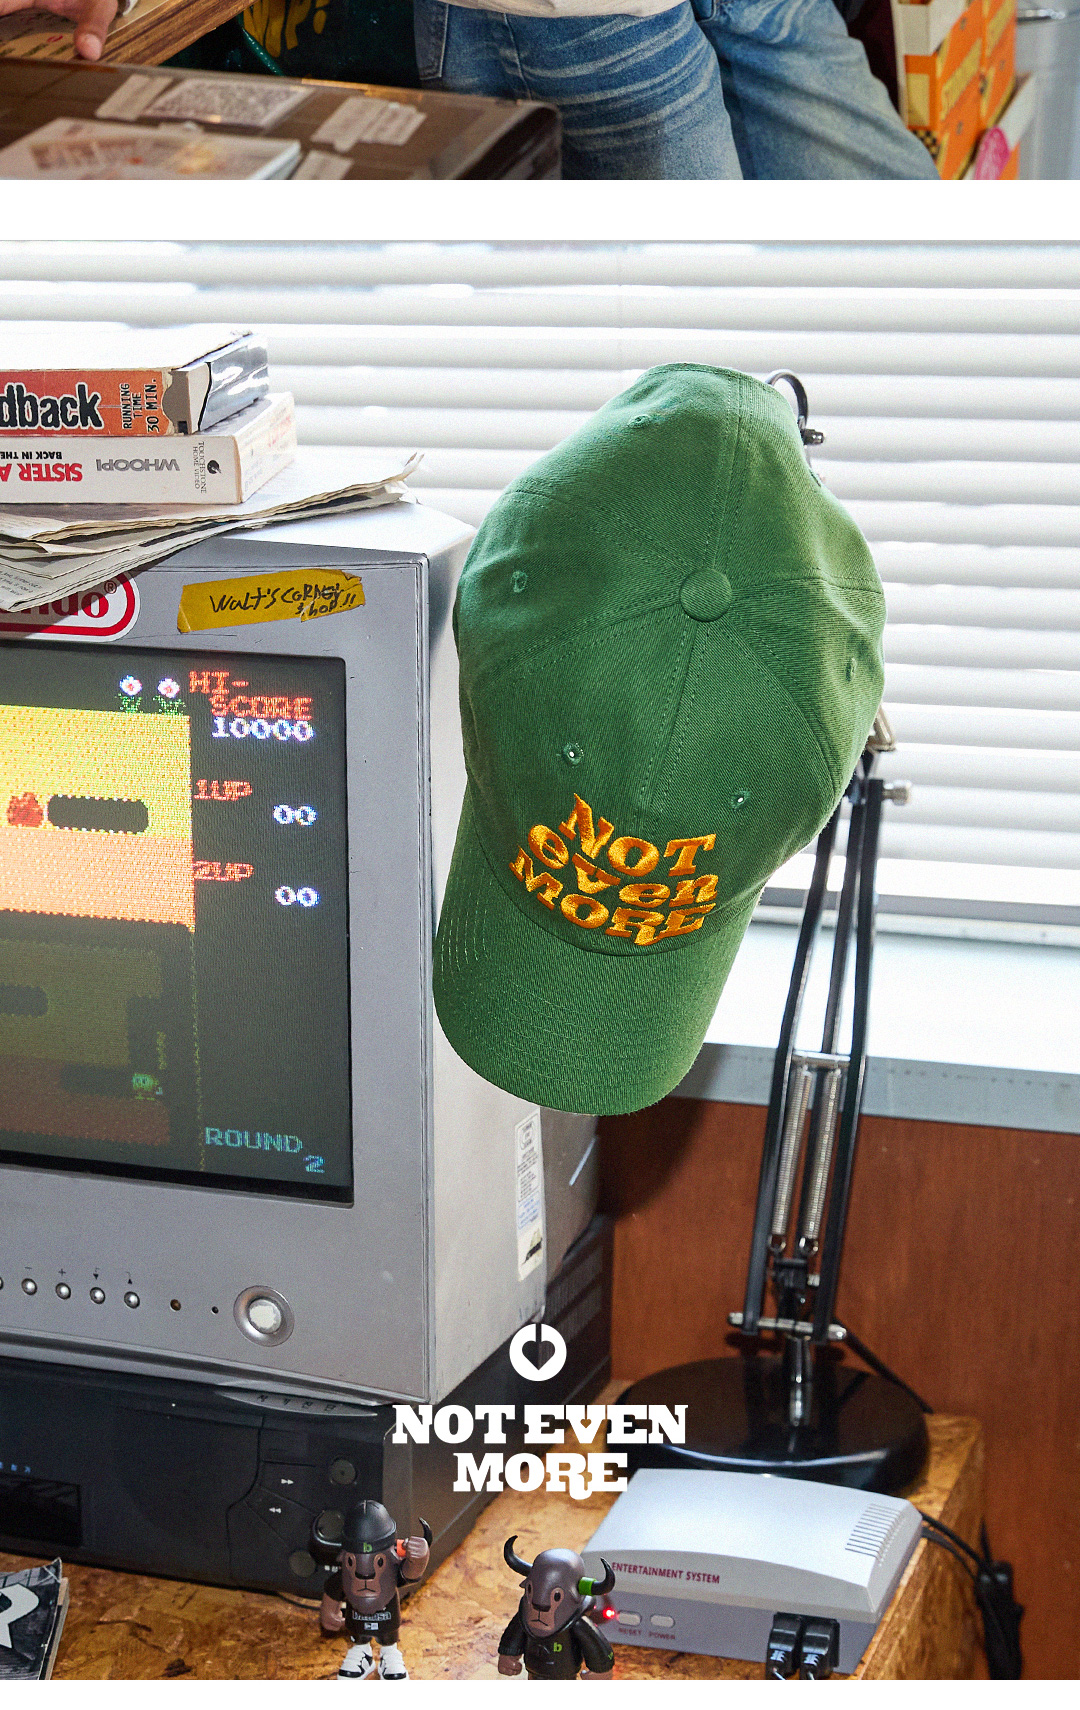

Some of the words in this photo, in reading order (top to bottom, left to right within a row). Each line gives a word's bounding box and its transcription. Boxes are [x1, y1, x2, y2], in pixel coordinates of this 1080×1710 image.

[120, 383, 132, 429] RUNNING
[133, 392, 142, 419] TIME
[145, 378, 158, 412] MIN.
[147, 416, 160, 433] 30
[0, 451, 19, 460] THE
[22, 451, 33, 460] IN
[35, 451, 62, 460] BACK
[96, 459, 180, 472] WHOOPI
[18, 463, 83, 482] SISTER
[198, 441, 207, 494] TOUCHSTONE
[189, 671, 250, 694] HI-
[211, 695, 313, 720] SCORE
[211, 717, 314, 741] 10000
[194, 779, 253, 802] 1UP
[273, 804, 317, 826] 00
[558, 792, 716, 877] NOT
[529, 824, 718, 907] even
[275, 886, 319, 907] 00
[509, 845, 717, 946] MORE
[206, 1127, 303, 1154] ROUND
[304, 1155, 325, 1174] 2
[612, 1562, 683, 1580] ENTERTAINMENT
[686, 1570, 720, 1584] SYSTEM
[618, 1627, 642, 1636] RESET
[649, 1632, 676, 1640] POWER
